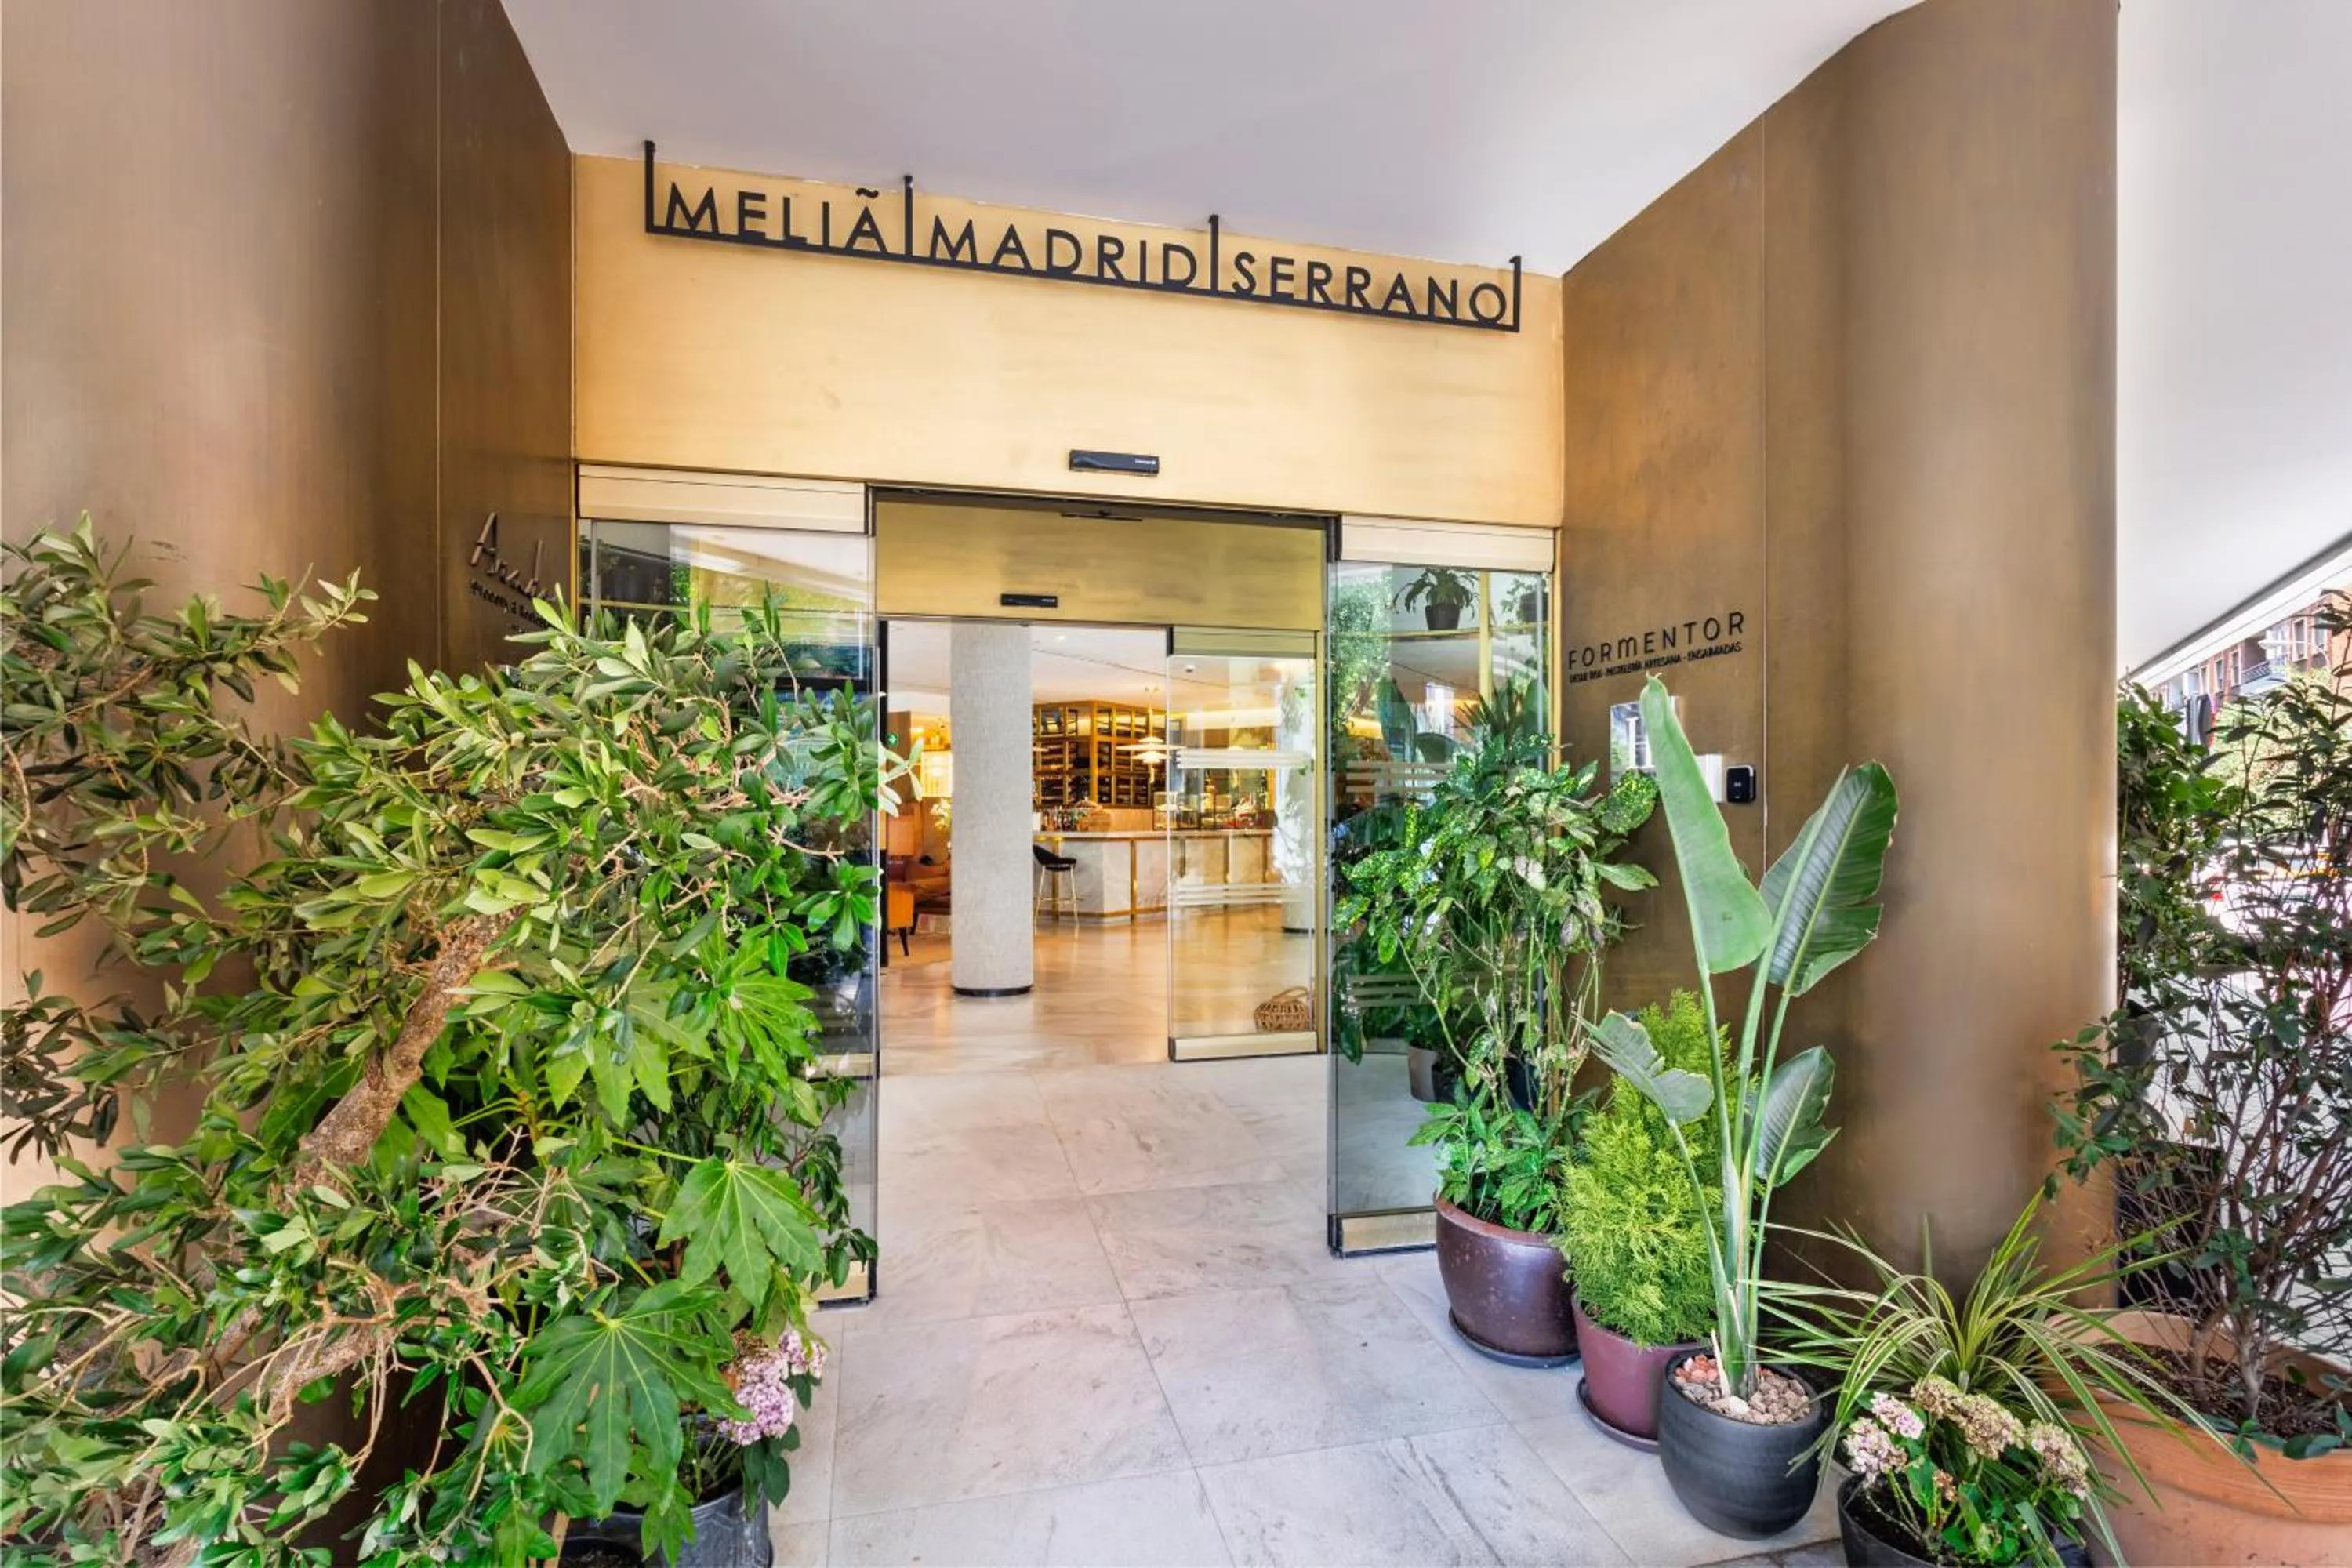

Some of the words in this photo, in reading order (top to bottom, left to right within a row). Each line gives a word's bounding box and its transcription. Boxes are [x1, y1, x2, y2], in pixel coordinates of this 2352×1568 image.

[930, 215, 1198, 287] MADRID
[1232, 251, 1507, 324] SERRANO
[1569, 611, 1744, 669] FORMENTOR
